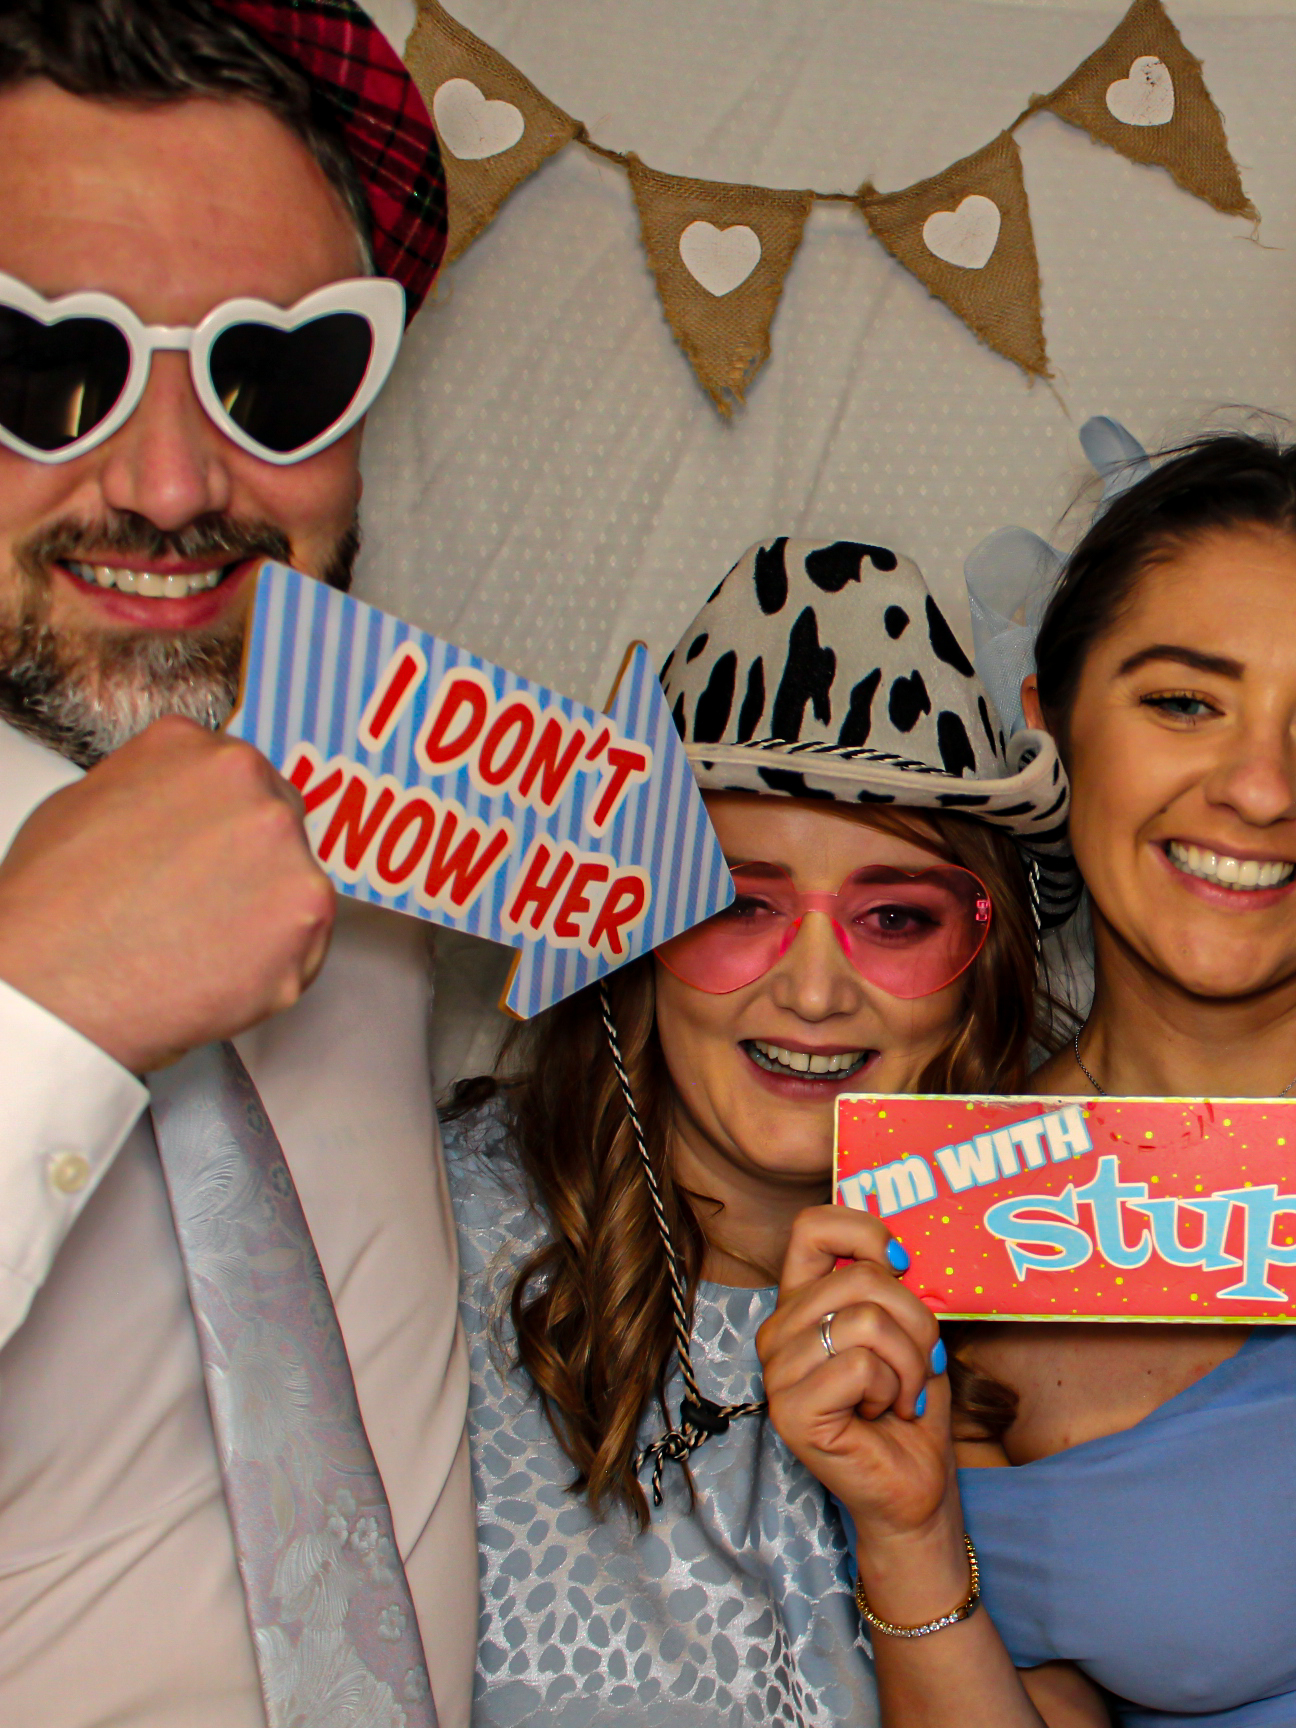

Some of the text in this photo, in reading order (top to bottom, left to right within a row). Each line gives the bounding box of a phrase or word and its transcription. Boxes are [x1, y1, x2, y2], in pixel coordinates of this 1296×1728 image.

[367, 652, 648, 829] I DON'T
[507, 842, 647, 957] HER
[934, 1104, 1094, 1193] WITH
